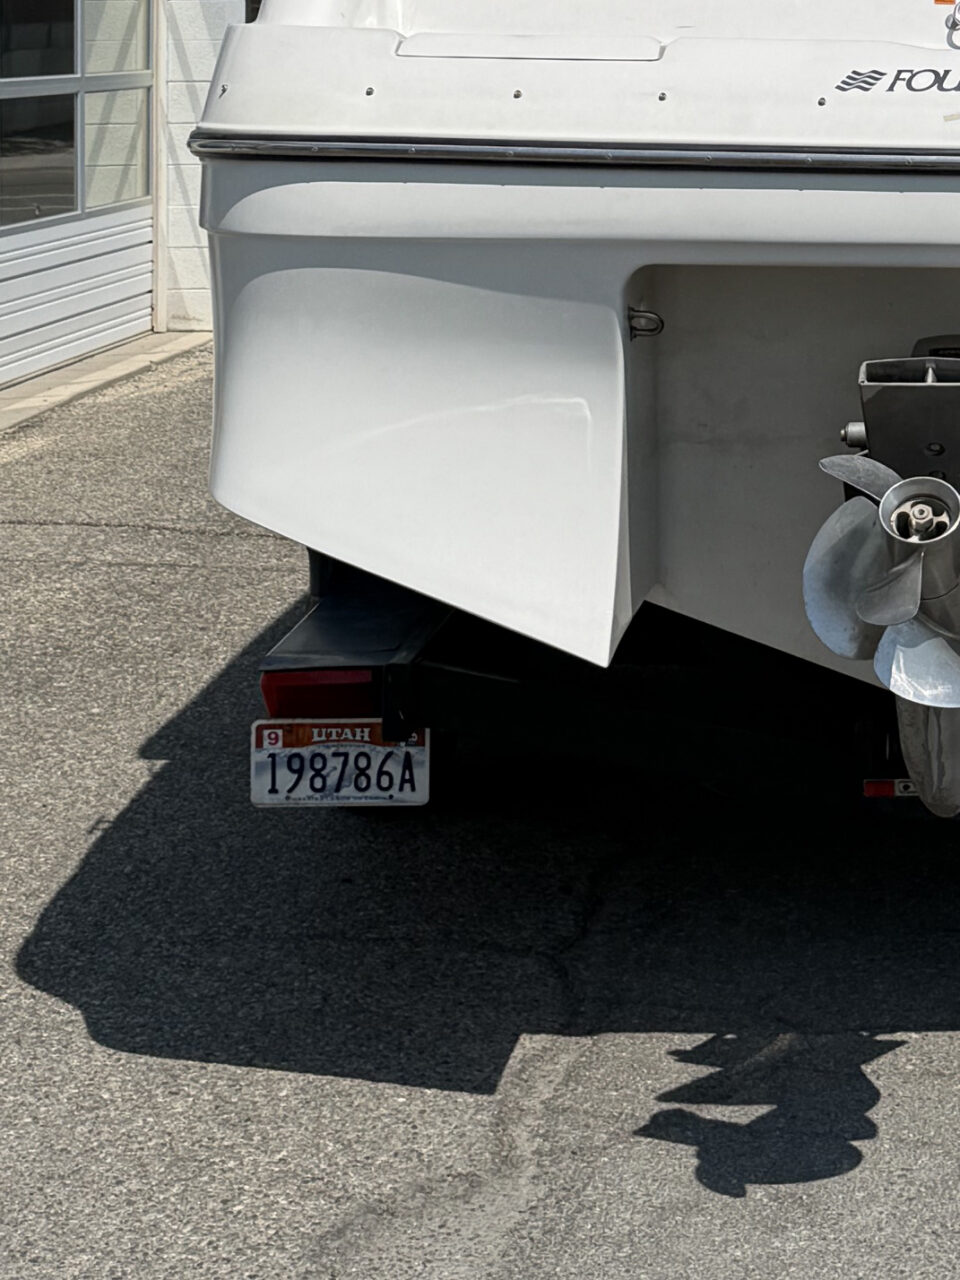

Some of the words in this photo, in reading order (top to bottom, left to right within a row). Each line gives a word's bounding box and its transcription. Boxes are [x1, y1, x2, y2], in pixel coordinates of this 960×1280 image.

[267, 731, 279, 746] 9
[312, 727, 371, 742] UTAH
[267, 750, 416, 795] 198786A
